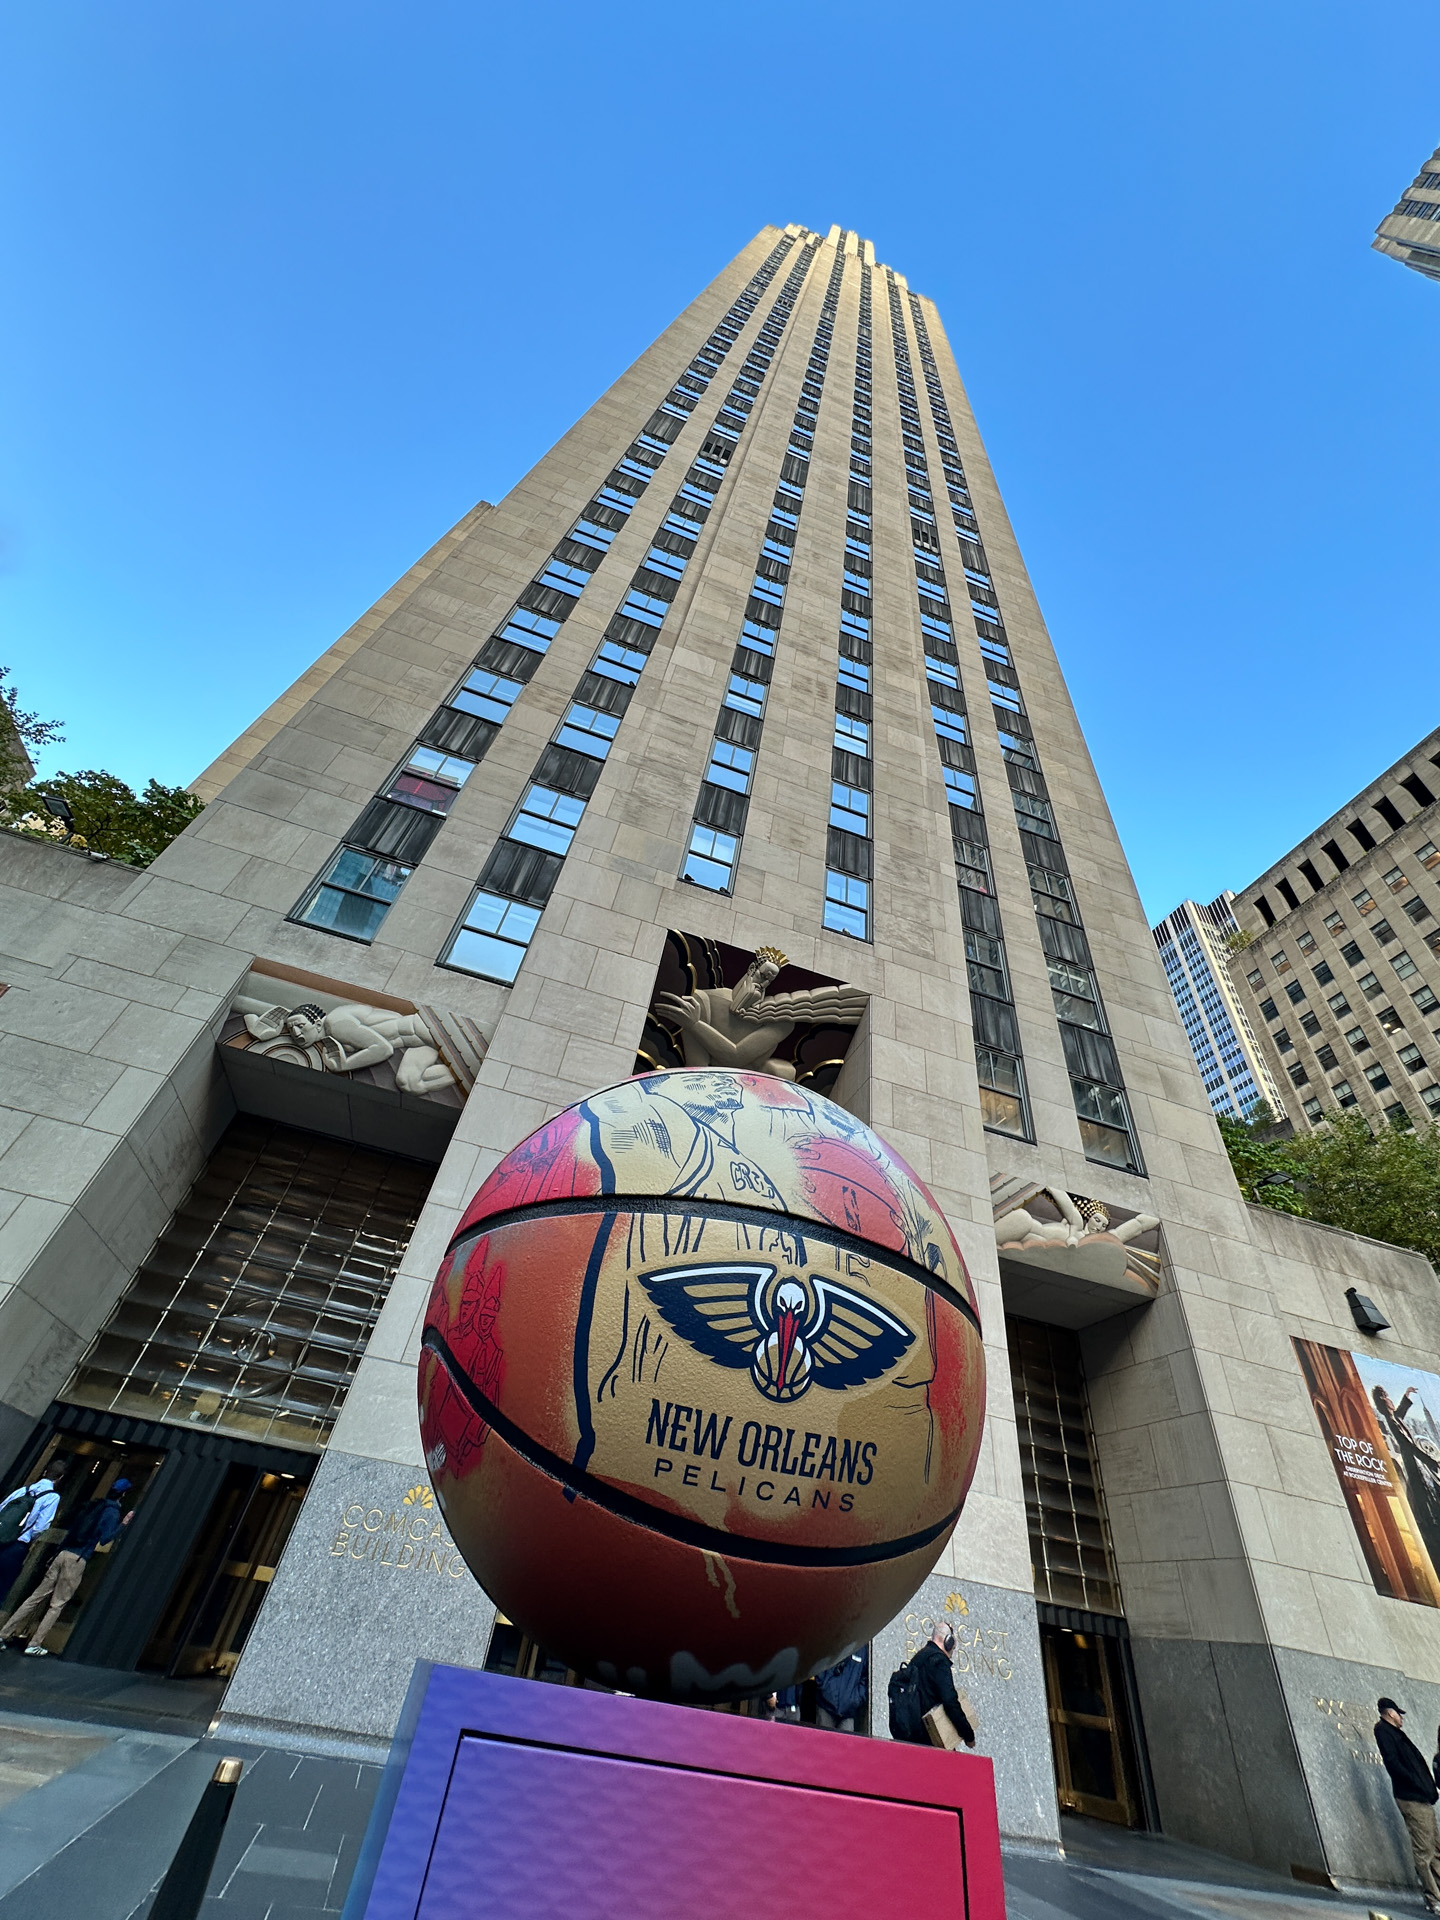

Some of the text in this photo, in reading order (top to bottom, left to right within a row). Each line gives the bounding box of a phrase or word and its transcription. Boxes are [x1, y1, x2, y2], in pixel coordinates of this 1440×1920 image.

[645, 1398, 878, 1486] NEW ORLEANS
[1334, 1447, 1387, 1473] THE ROCK
[1335, 1434, 1374, 1455] TOP OF
[653, 1457, 855, 1512] PELICANS
[343, 1505, 456, 1547] COMCA
[331, 1532, 467, 1578] BUILDING
[905, 1614, 1008, 1653] COCAST
[906, 1640, 1012, 1680] BDING
